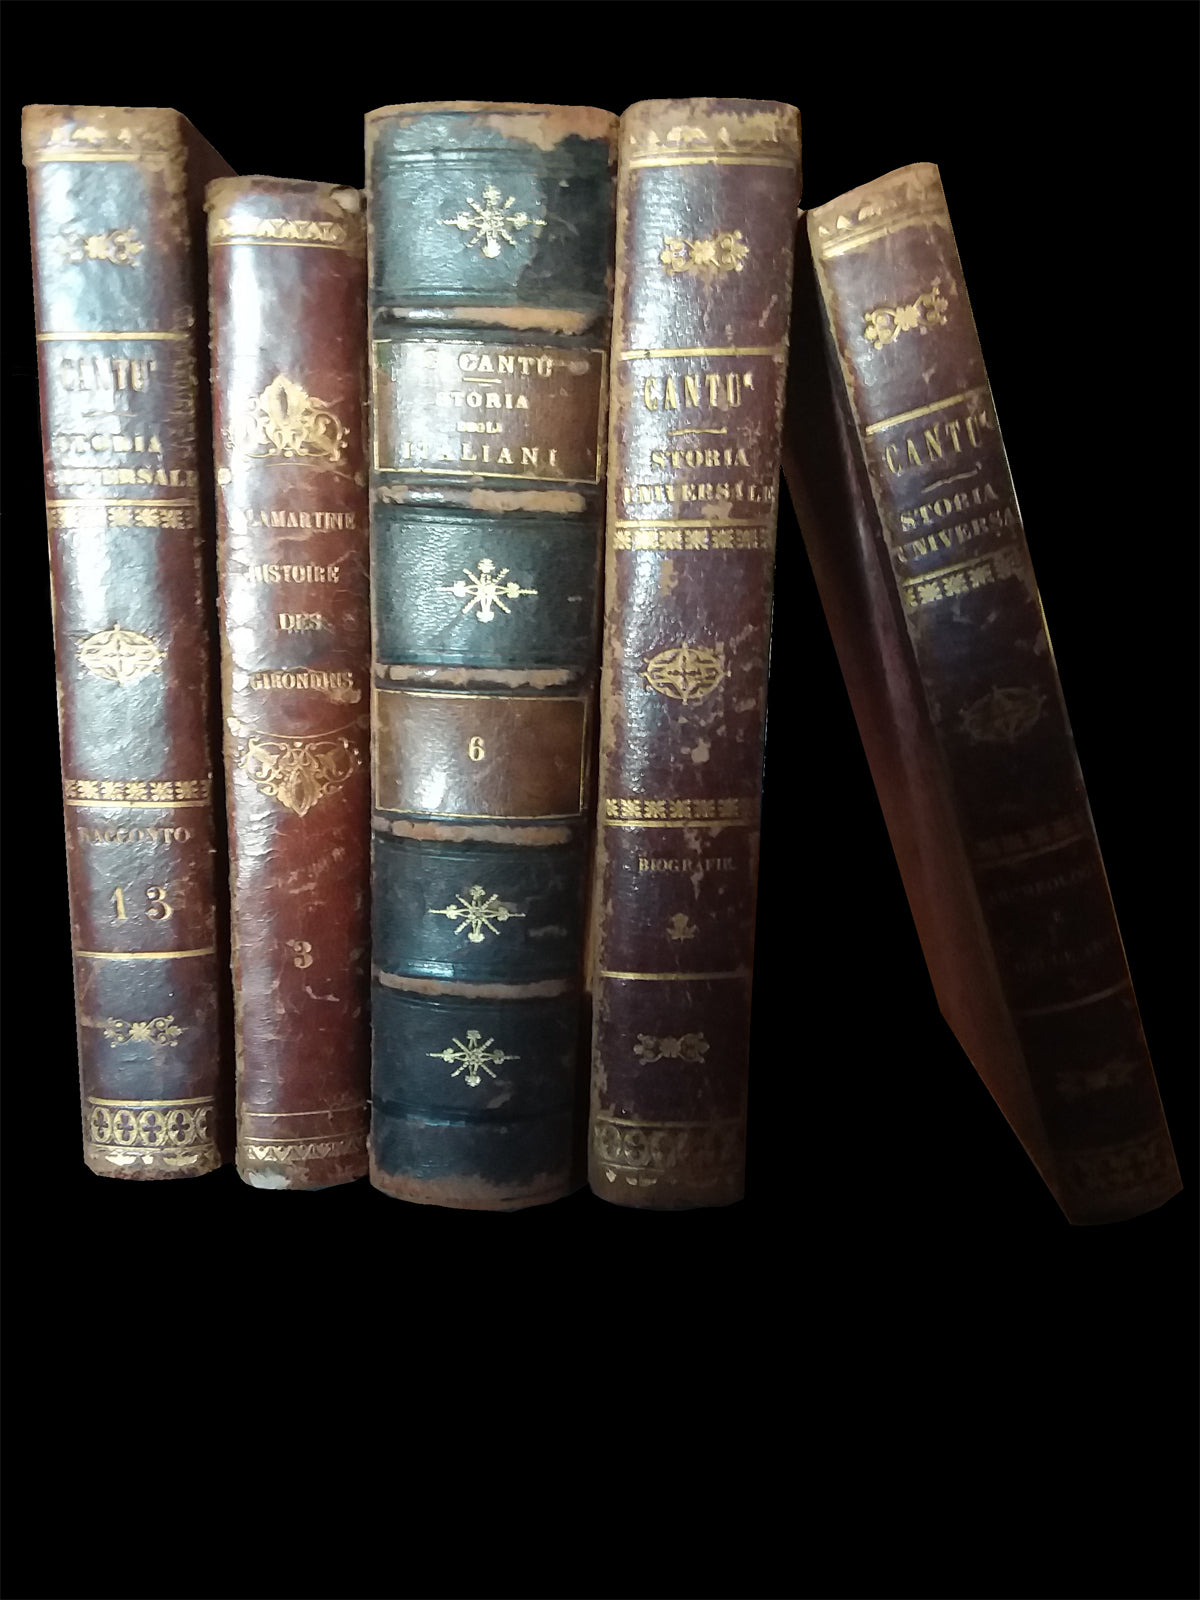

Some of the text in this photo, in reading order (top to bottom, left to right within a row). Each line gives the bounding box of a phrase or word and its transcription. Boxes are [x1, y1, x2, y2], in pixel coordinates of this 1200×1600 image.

[436, 390, 529, 409] STORIA
[651, 447, 751, 468] STORIA
[900, 483, 999, 531] STORIA
[246, 509, 356, 530] LAMARTINE
[249, 563, 341, 584] HISTOIRE
[278, 612, 323, 632] DES
[468, 735, 485, 761] 6
[294, 941, 314, 969] 3
